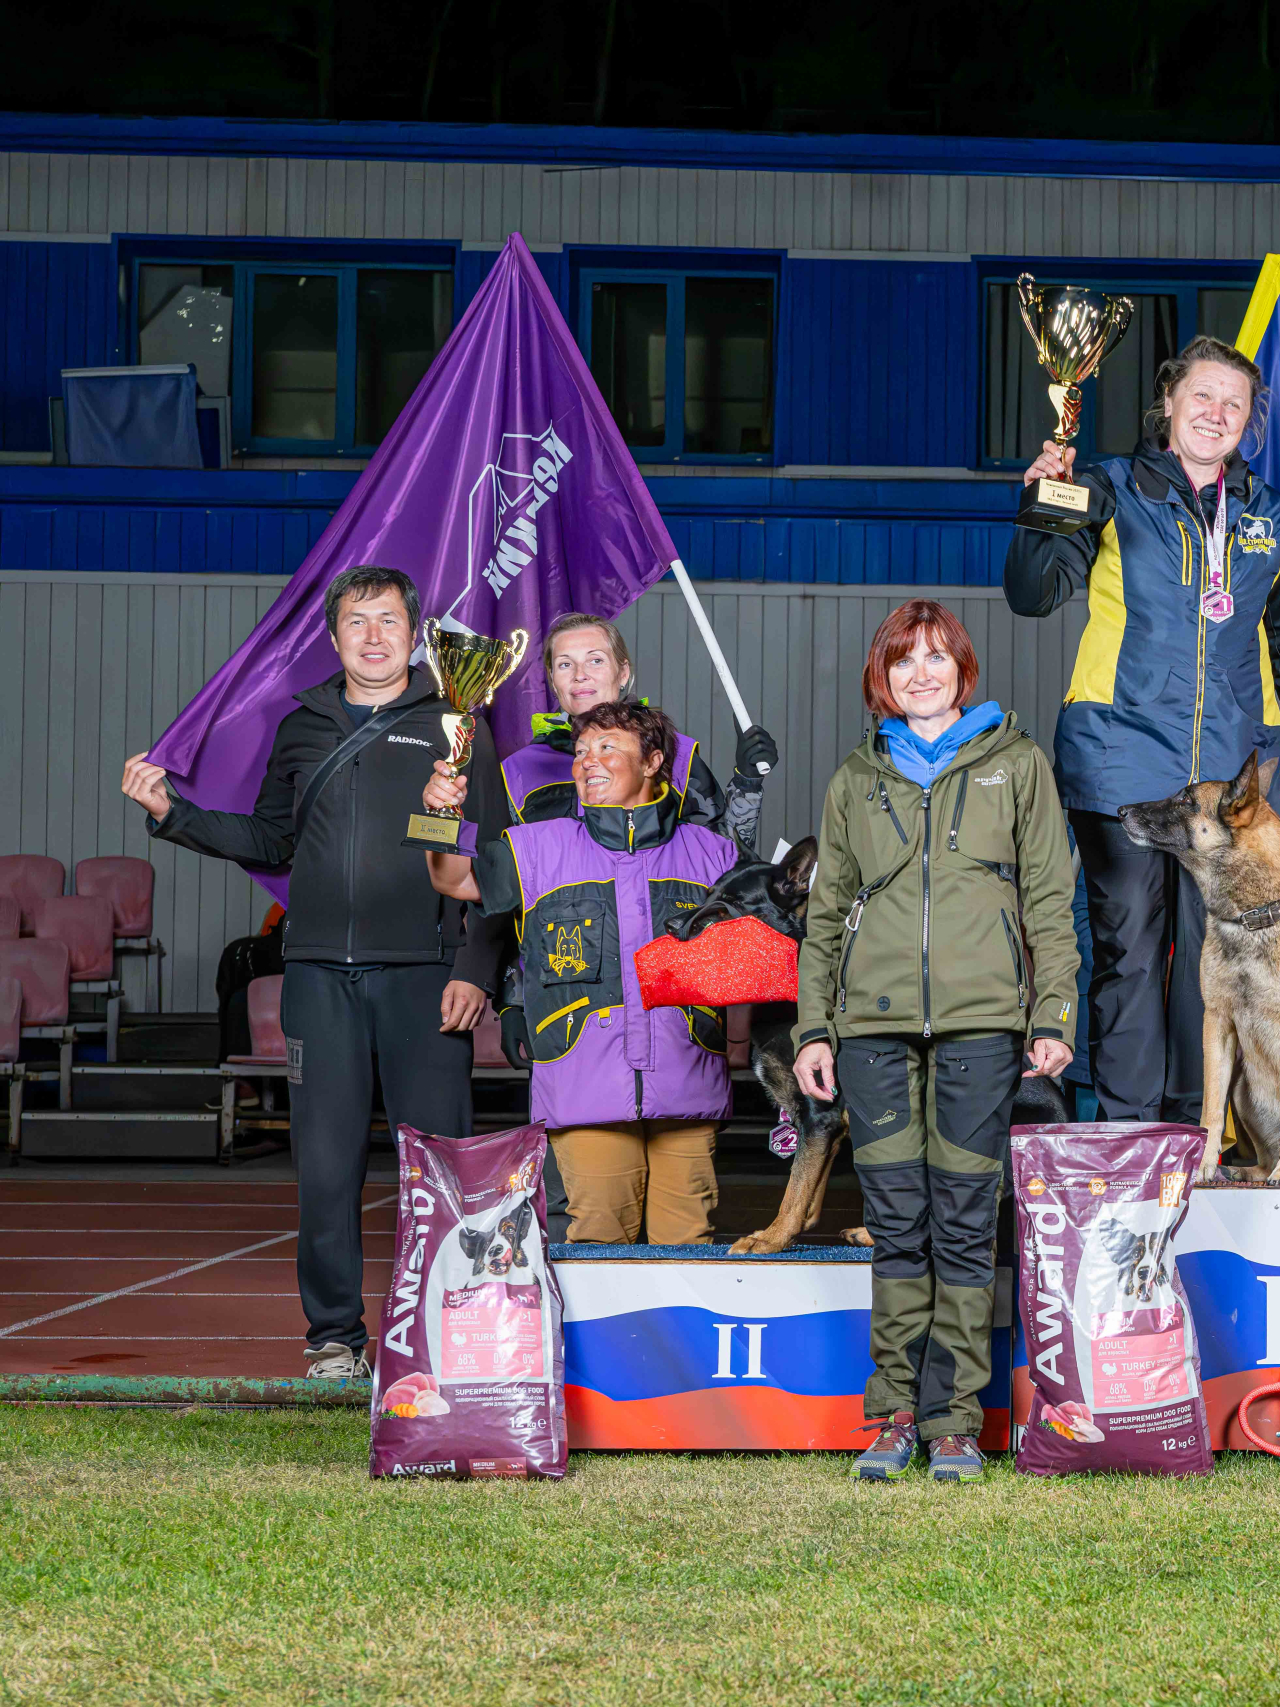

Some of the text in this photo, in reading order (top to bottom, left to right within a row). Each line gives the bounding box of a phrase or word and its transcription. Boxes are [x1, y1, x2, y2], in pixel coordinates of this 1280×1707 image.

[1025, 1203, 1067, 1386] Award
[448, 1311, 479, 1320] ADULT
[711, 1323, 768, 1379] II
[1098, 1340, 1128, 1350] ADULT
[457, 1353, 476, 1365] 68%
[522, 1353, 535, 1365] 0%
[1121, 1360, 1156, 1372] TURKEY
[455, 1388, 511, 1396] SUPERPREMIUM
[1109, 1382, 1127, 1395] 68%
[1143, 1379, 1157, 1392] 0%
[1109, 1404, 1192, 1425] SUPERPREMIUM DOG FOOD
[509, 1416, 525, 1428] 12
[1162, 1438, 1176, 1451] 12
[392, 1460, 456, 1476] Award
